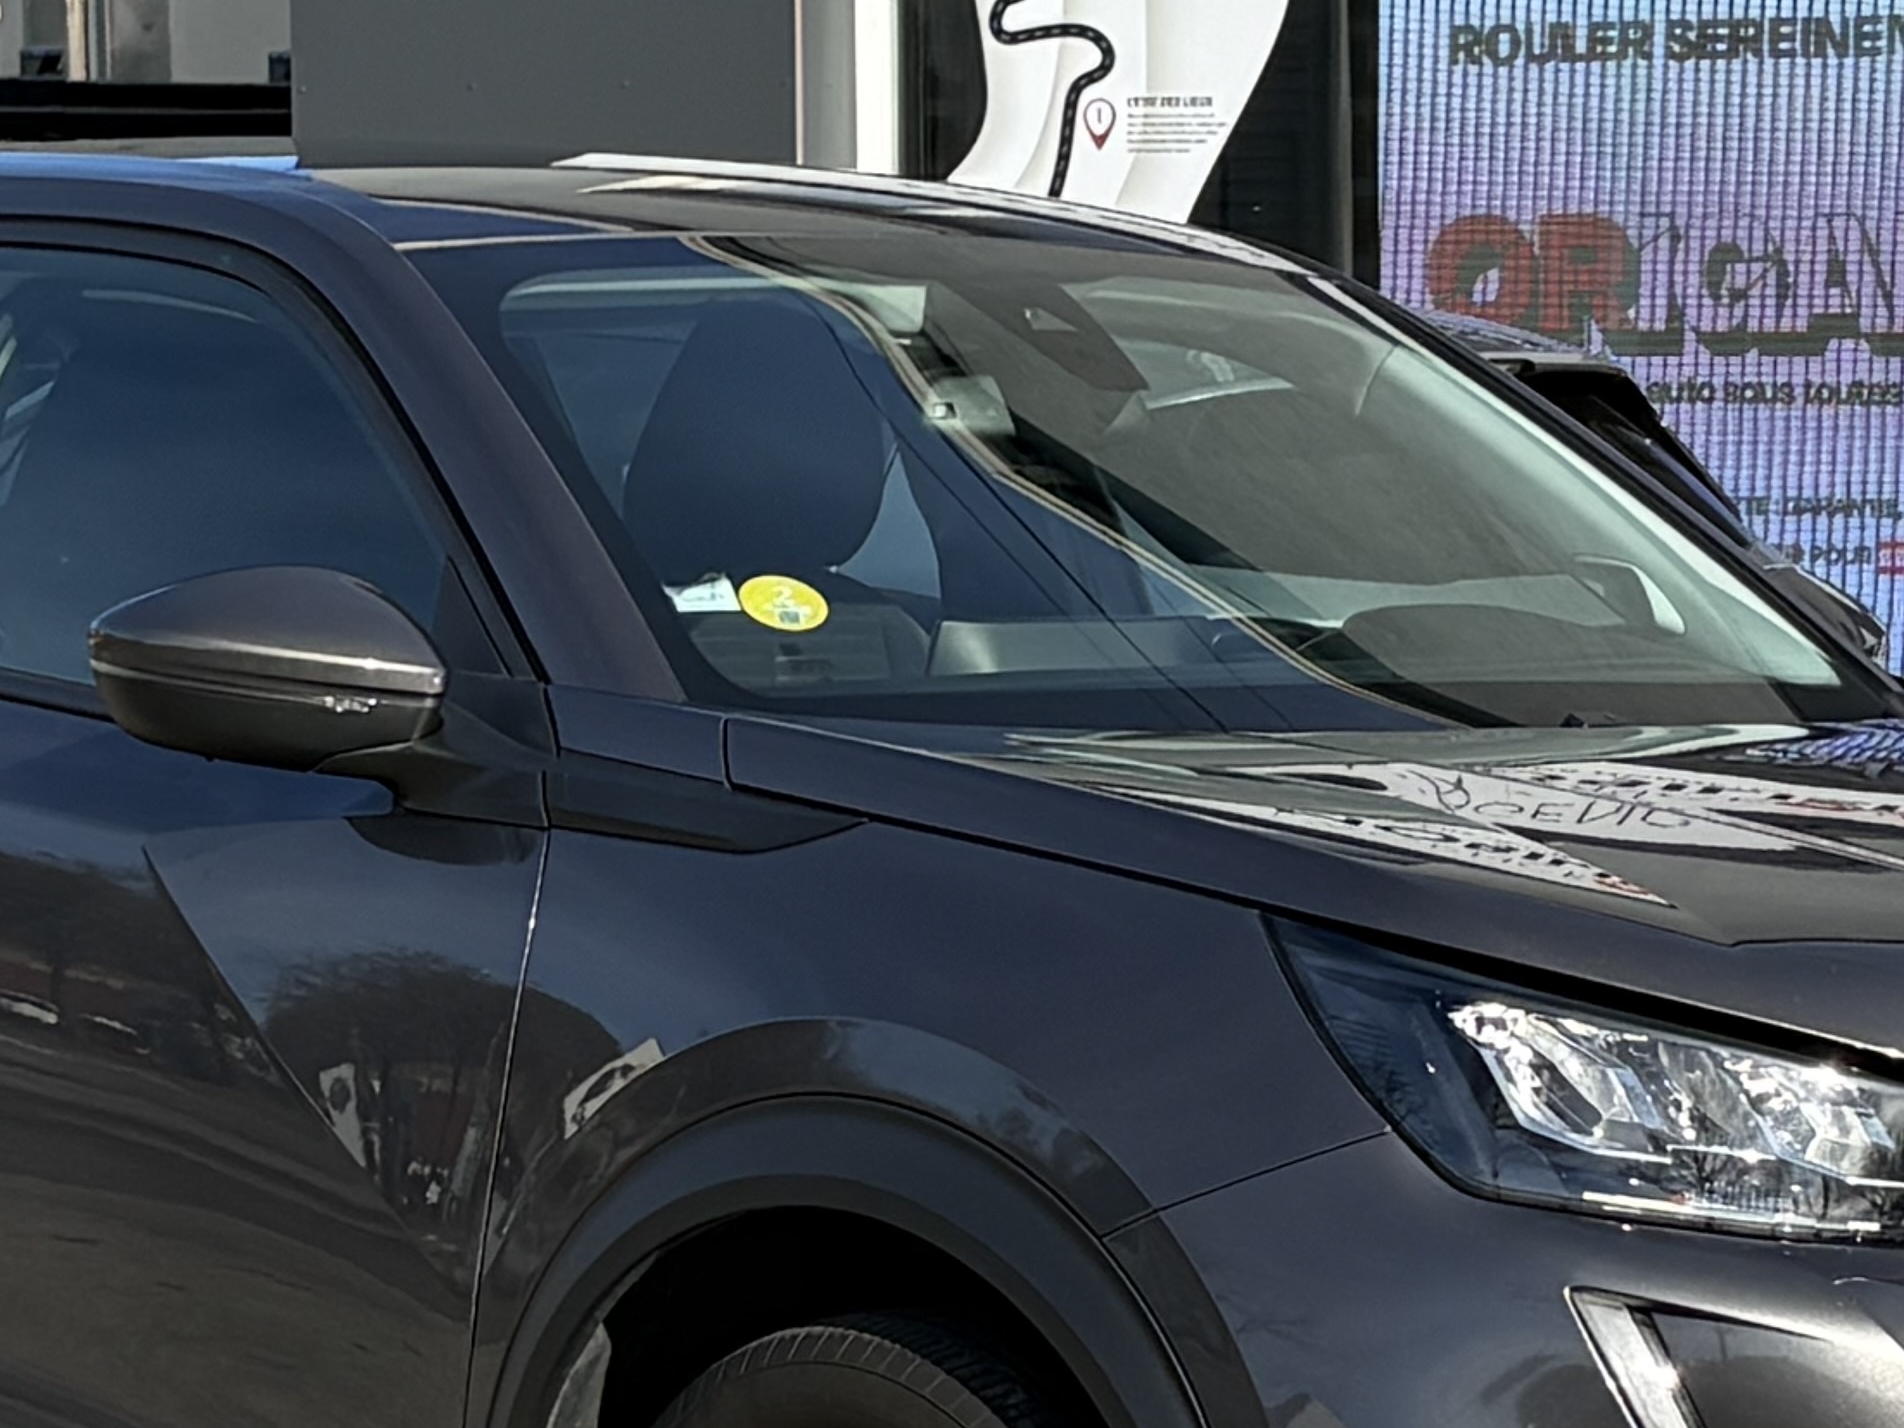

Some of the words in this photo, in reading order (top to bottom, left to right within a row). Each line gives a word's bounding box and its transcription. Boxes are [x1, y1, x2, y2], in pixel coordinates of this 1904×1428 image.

[1449, 19, 1652, 65] ROULER
[1724, 380, 1795, 405] sous
[1802, 379, 1901, 406] toutes
